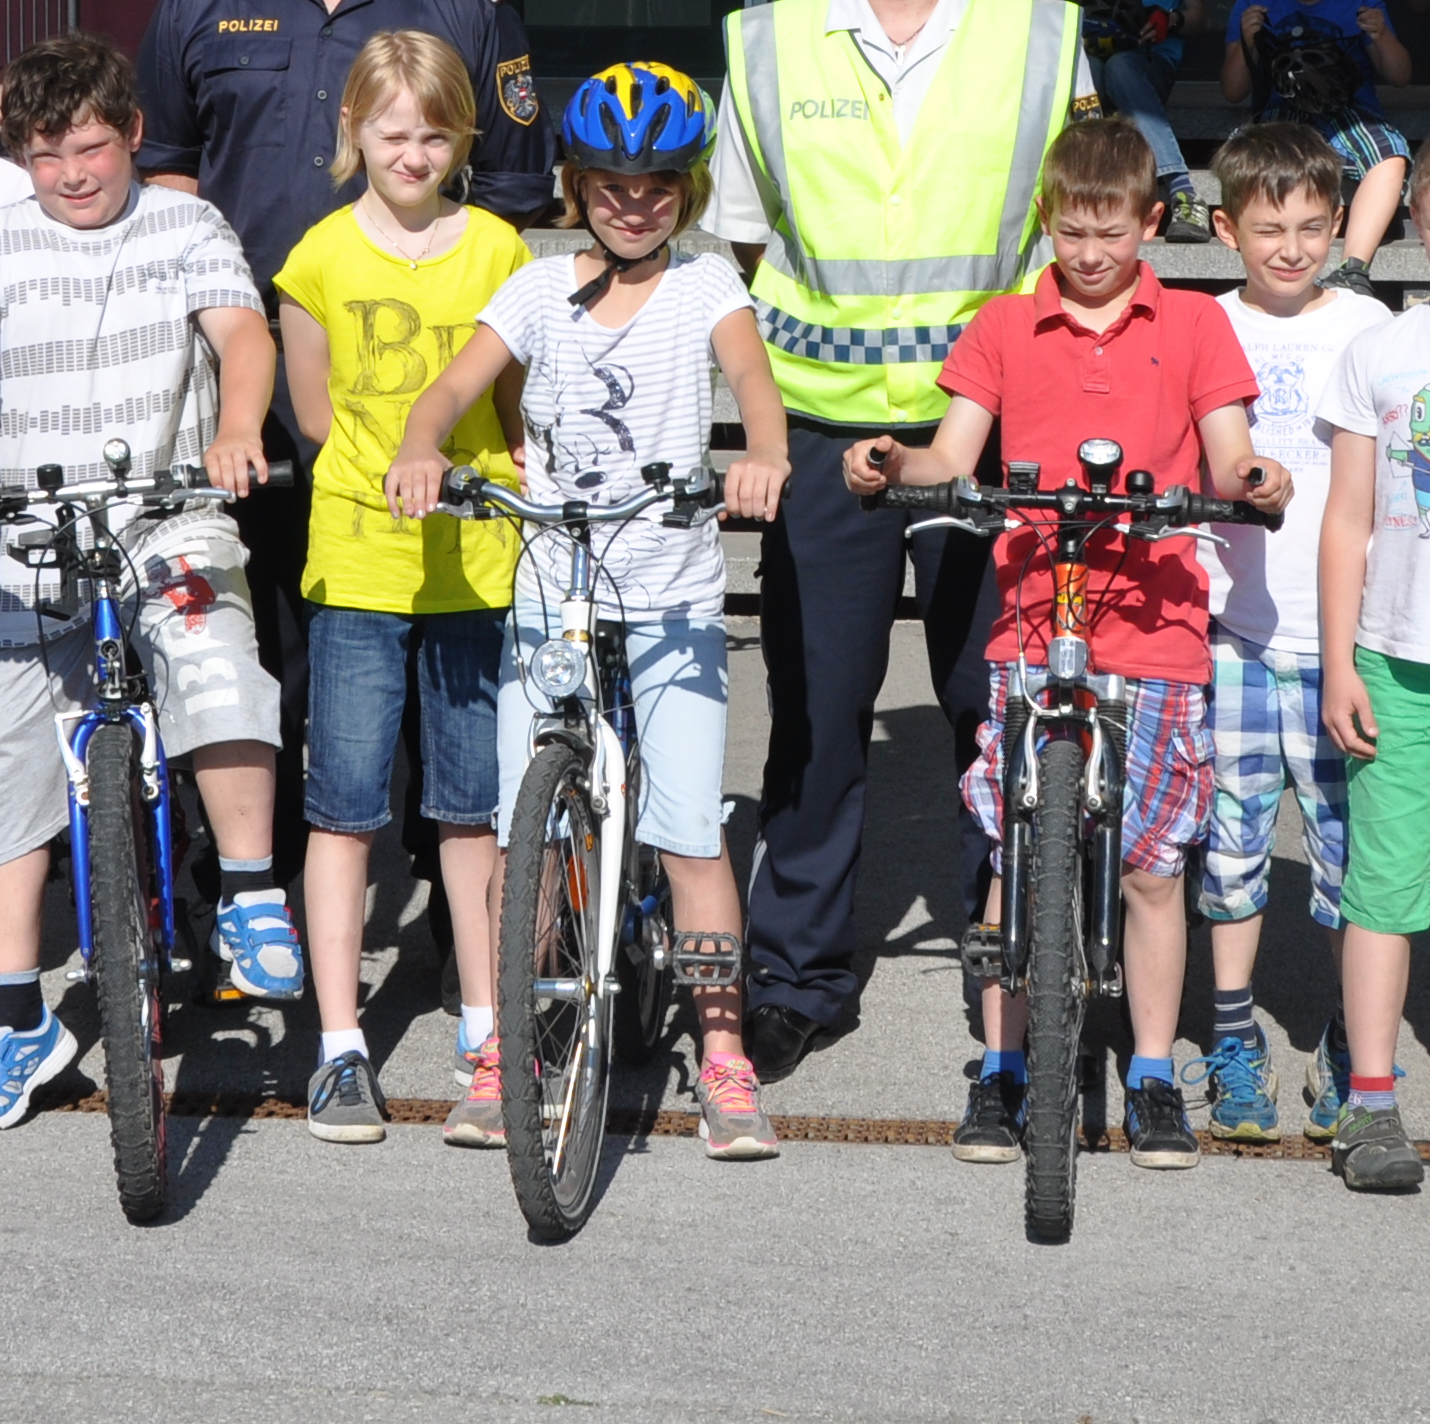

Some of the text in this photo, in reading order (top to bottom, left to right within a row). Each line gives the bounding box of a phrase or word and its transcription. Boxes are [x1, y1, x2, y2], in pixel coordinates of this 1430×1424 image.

[218, 19, 278, 33] POLIZEI
[789, 99, 870, 121] POLIZEI
[1242, 342, 1269, 352] ALPH
[1273, 342, 1319, 353] LAUREN
